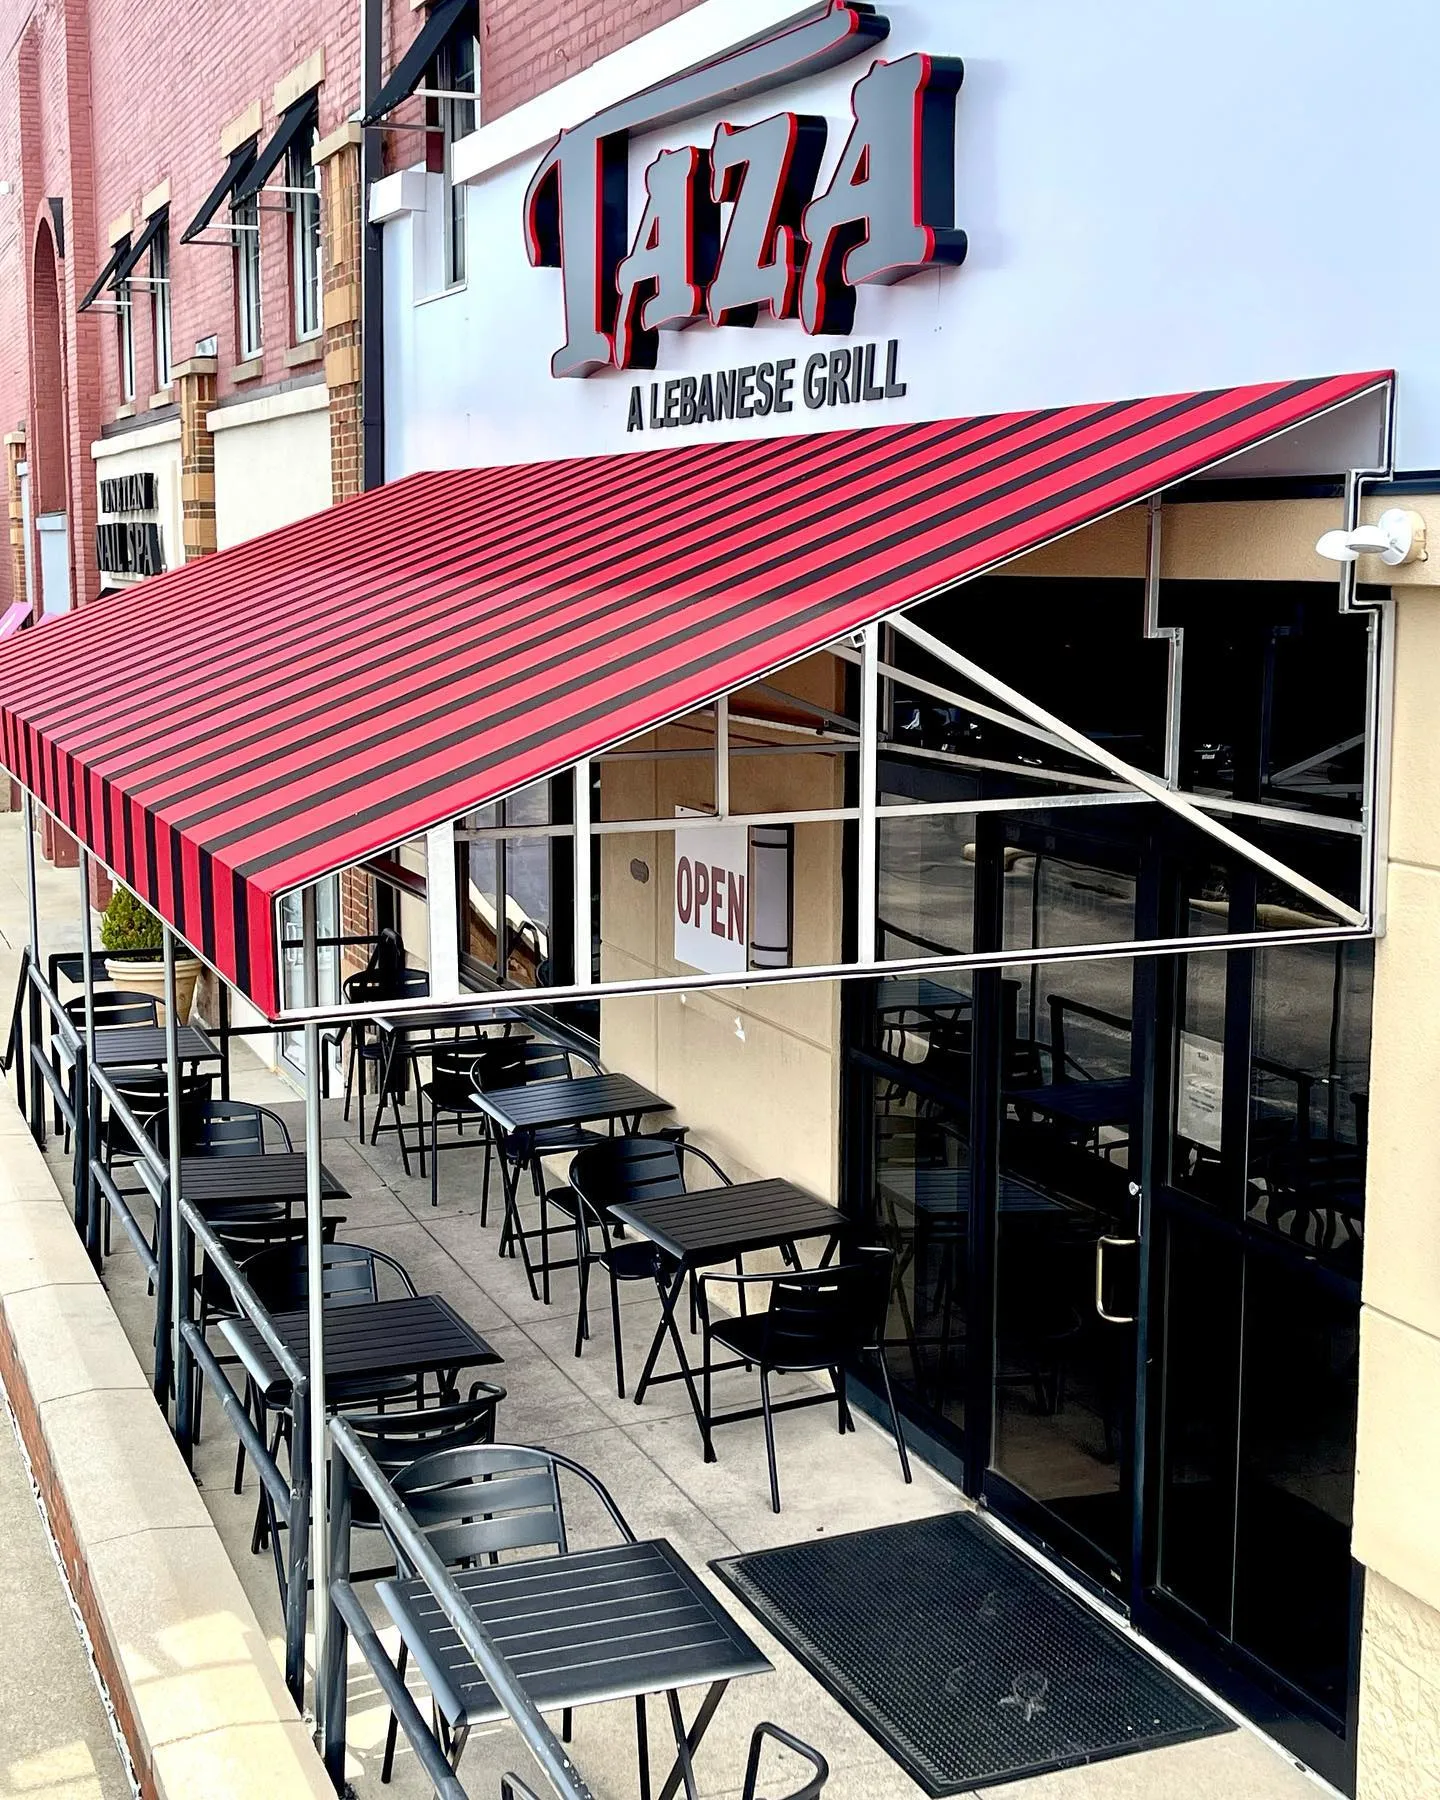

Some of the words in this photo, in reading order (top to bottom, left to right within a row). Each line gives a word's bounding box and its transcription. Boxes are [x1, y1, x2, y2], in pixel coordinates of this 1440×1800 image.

[523, 0, 967, 378] TAZA
[626, 385, 643, 432] A
[649, 358, 796, 429] LEBANESE
[803, 339, 907, 409] GRILL
[96, 523, 128, 573] NAIL
[127, 523, 160, 576] SPA
[676, 856, 745, 946] OPEN
